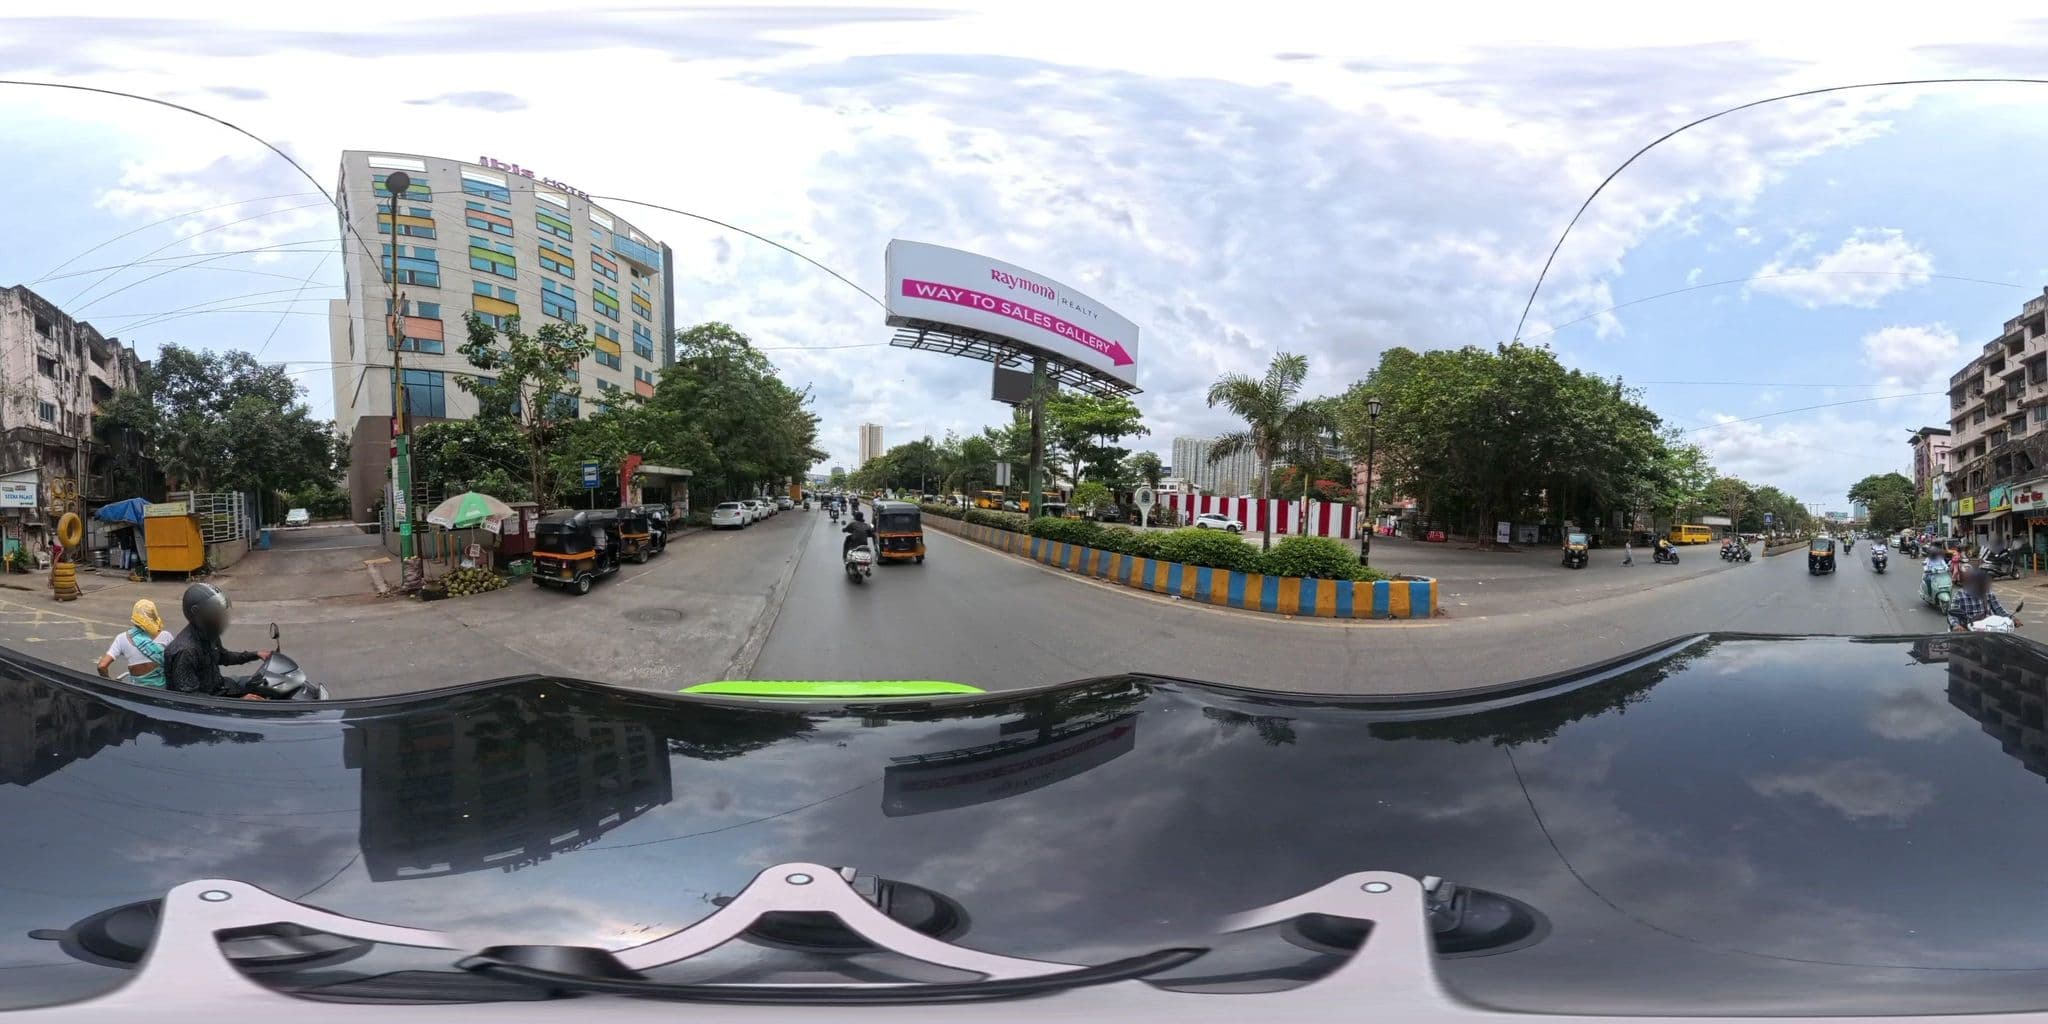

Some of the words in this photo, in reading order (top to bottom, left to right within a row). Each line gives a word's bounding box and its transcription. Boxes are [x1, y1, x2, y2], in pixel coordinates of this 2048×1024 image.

[480, 156, 535, 178] ibis
[543, 177, 593, 202] HOTEL
[915, 283, 963, 301] WAY
[970, 294, 995, 309] TO
[1001, 302, 1051, 328] SALES
[1055, 322, 1110, 353] GALLERY
[991, 269, 1055, 300] Raymond
[1061, 297, 1099, 319] REALTY
